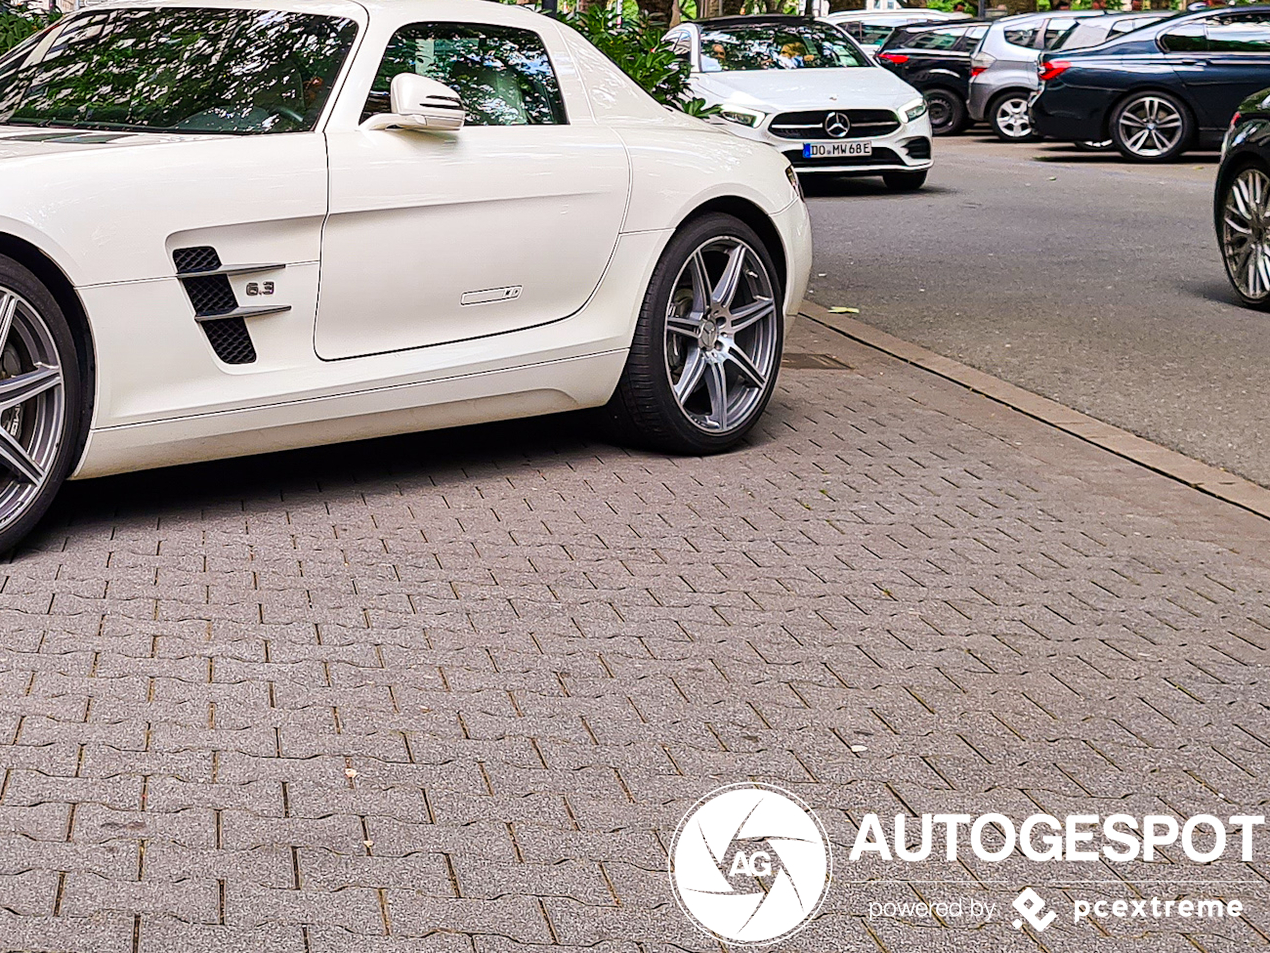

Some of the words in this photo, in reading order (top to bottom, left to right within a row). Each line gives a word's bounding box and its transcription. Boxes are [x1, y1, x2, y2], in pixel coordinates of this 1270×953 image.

[812, 144, 826, 155] DO
[832, 143, 847, 155] MW
[246, 281, 275, 296] 6.3
[10, 403, 20, 436] MG
